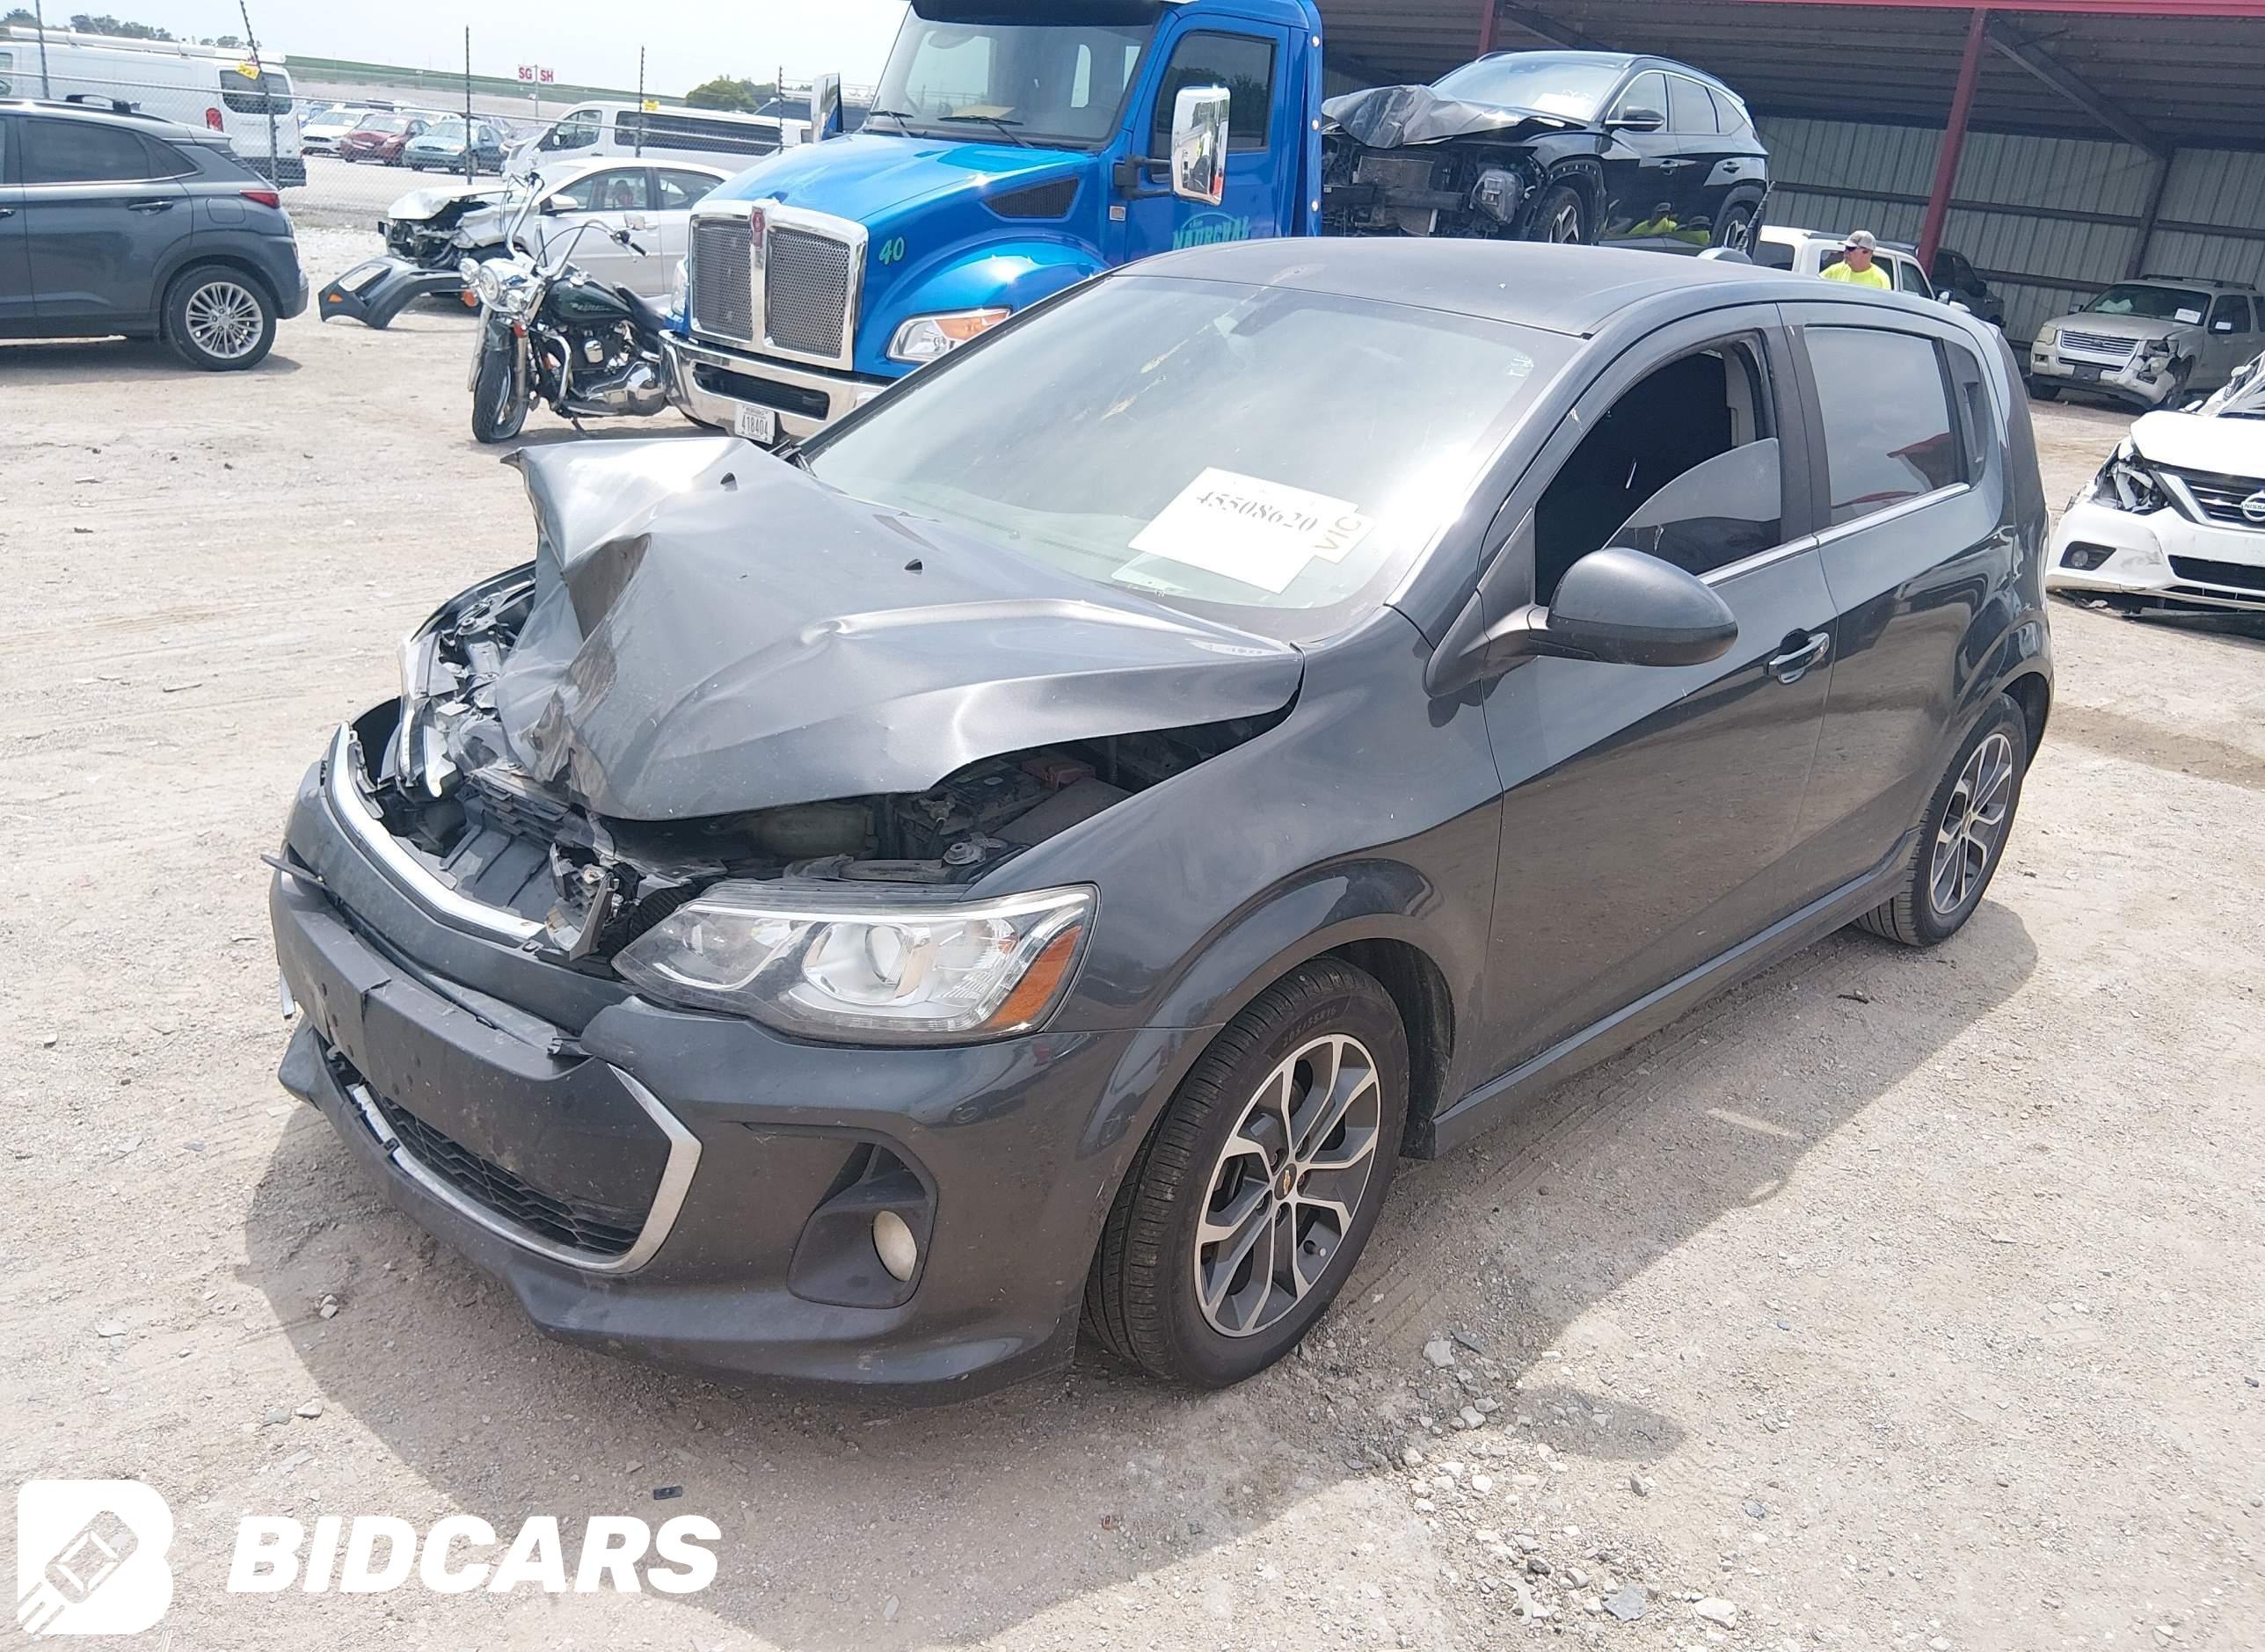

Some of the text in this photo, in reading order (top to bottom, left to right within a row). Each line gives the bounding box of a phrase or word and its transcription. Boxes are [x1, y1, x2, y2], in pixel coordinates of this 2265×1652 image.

[519, 67, 533, 79] SG
[540, 69, 554, 83] SH
[878, 237, 905, 265] 40
[741, 414, 768, 438] 418404
[1196, 491, 1318, 531] 45508620
